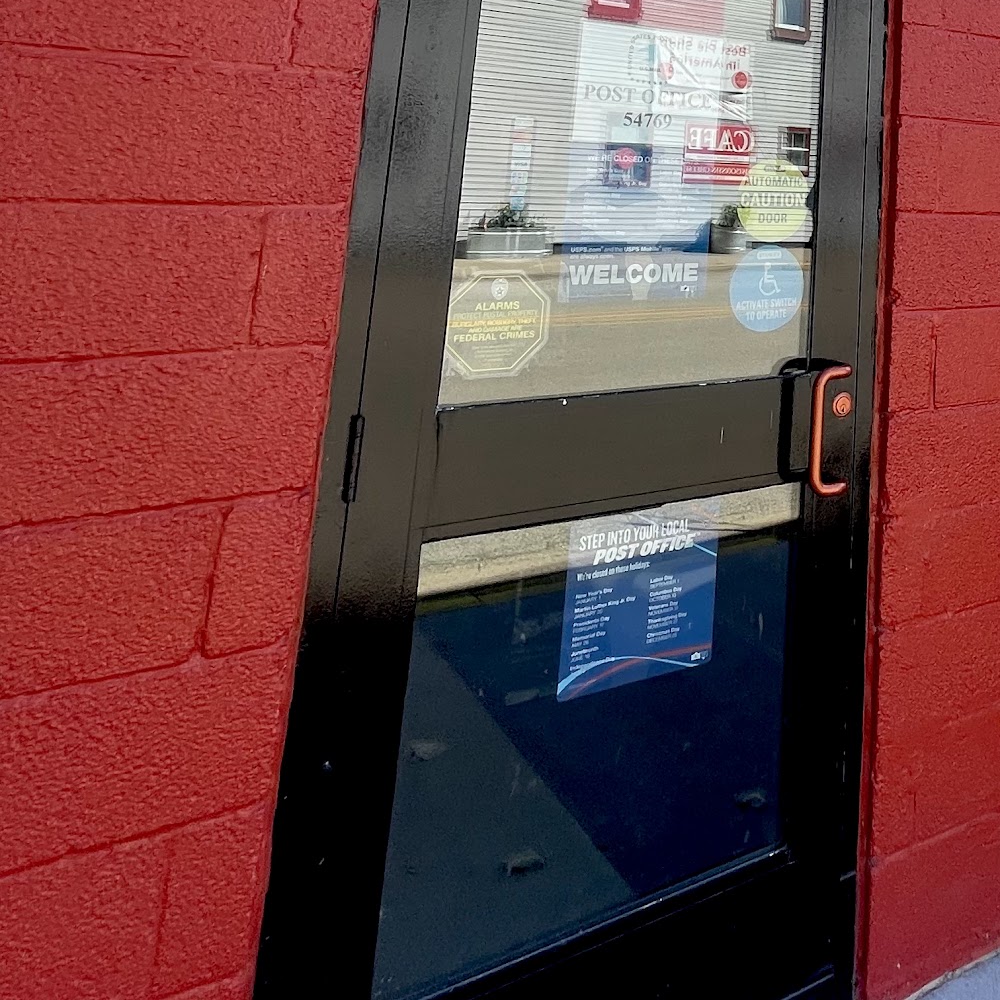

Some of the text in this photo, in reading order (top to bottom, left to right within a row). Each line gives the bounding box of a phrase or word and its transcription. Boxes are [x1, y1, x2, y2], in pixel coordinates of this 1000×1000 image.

[584, 83, 712, 109] POST OFFICE
[623, 112, 672, 129] 54769
[613, 154, 644, 163] CLOSED
[744, 176, 803, 187] AUTOMATIC
[740, 191, 807, 208] CAUTION
[758, 213, 787, 224] DOOR
[569, 263, 699, 286] WELCOME
[475, 301, 520, 311] ALARMS
[736, 298, 797, 311] ACTIVATE SWITCH
[453, 312, 482, 320] PROTECT
[507, 310, 538, 318] PROPERTY
[746, 309, 787, 321] TO OPERATE
[453, 330, 535, 343] FEDERAL CRIMES
[579, 518, 690, 551] STEP INTO YOUR LOCAL
[593, 542, 641, 566] POST
